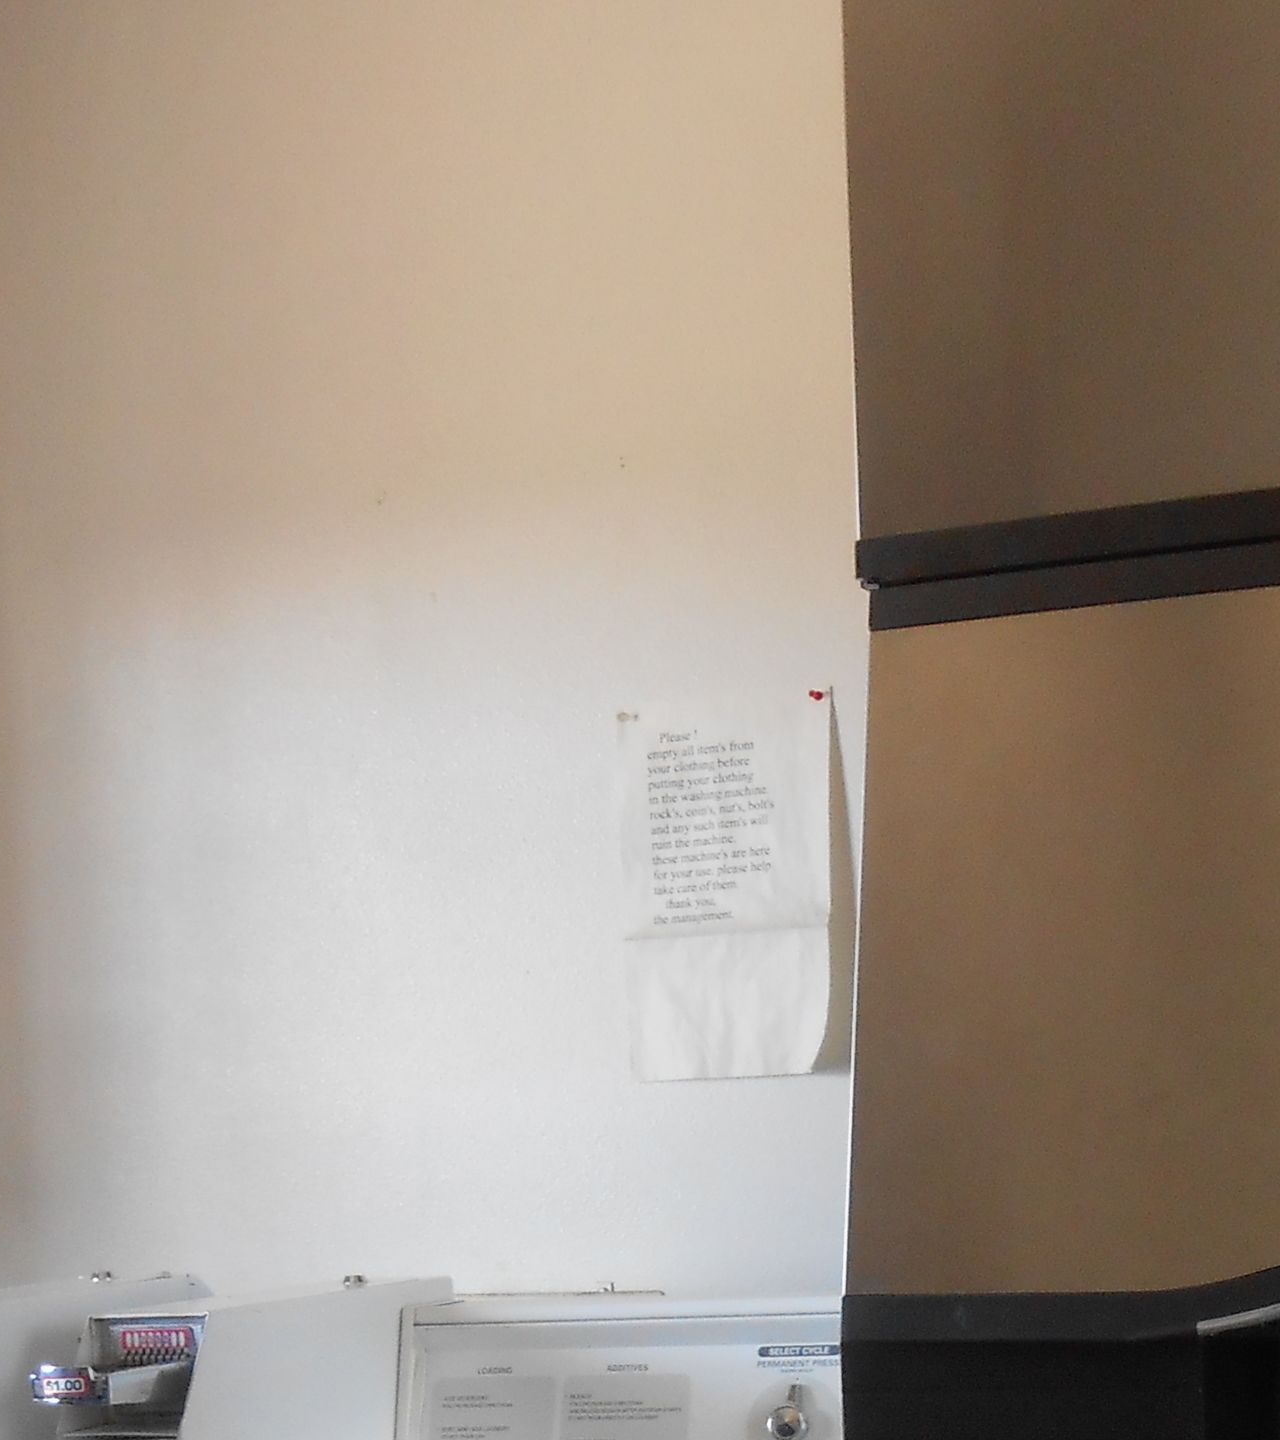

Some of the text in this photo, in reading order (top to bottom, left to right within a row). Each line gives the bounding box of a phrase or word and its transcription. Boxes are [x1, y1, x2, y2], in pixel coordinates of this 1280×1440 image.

[681, 745, 694, 756] all
[729, 740, 754, 751] from
[647, 757, 750, 777] your clothing before
[648, 771, 754, 792] putting your clothing
[649, 796, 658, 805] in
[661, 793, 678, 804] the
[681, 790, 722, 802] washing
[651, 824, 670, 835] and
[672, 824, 689, 836] any
[693, 821, 715, 832] such
[750, 814, 768, 825] will
[674, 839, 690, 848] the
[652, 855, 678, 866] these
[731, 849, 746, 858] are
[749, 846, 770, 857] here
[653, 870, 668, 880] for
[670, 869, 693, 881] your
[717, 864, 748, 877] please
[750, 861, 771, 873] help
[654, 885, 674, 895] take
[677, 884, 697, 893] care
[699, 880, 710, 891] of
[665, 897, 692, 909] thank
[654, 915, 669, 925] the
[768, 1346, 830, 1356] SELECT CYCLE
[477, 1366, 513, 1375] LOADING
[607, 1363, 649, 1372] ADDITIVES
[46, 1380, 83, 1392] $1.00
